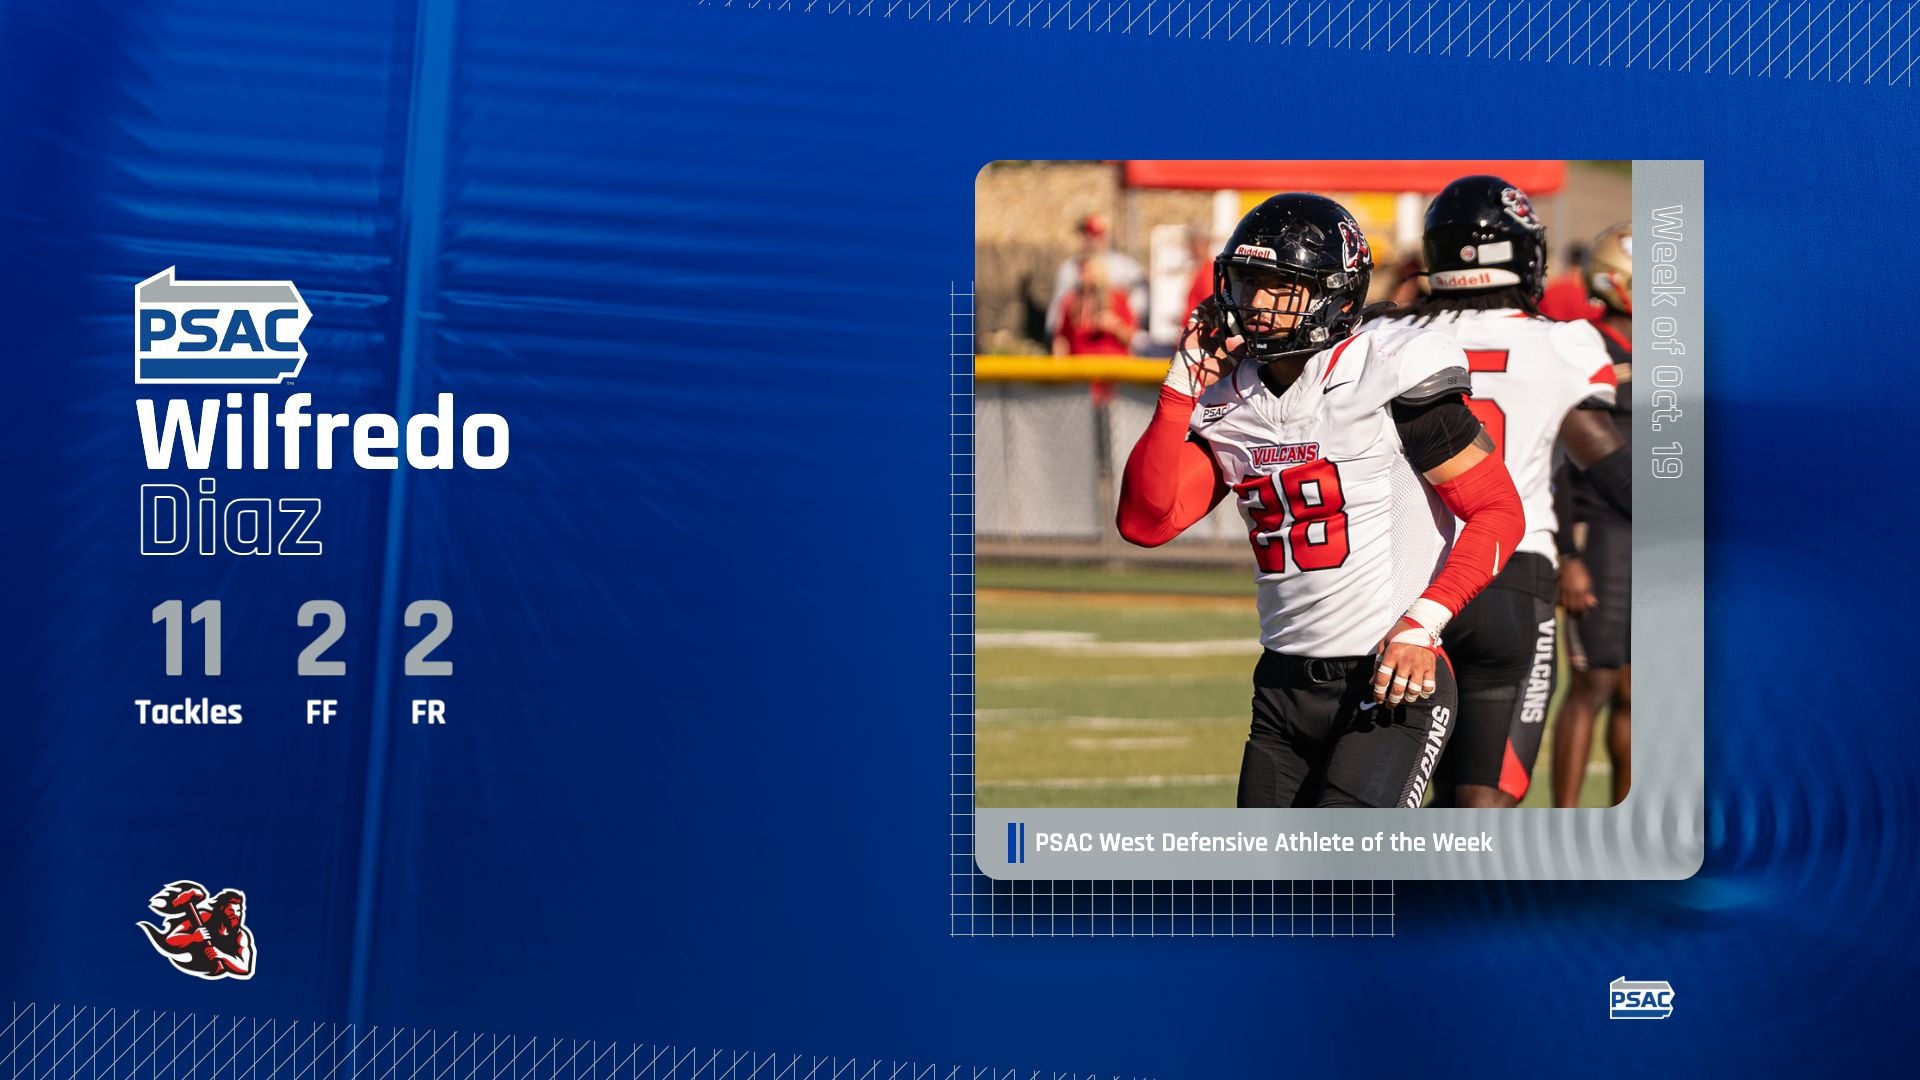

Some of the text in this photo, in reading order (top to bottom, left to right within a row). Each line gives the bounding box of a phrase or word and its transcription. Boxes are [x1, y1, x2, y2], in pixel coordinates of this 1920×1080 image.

[1238, 246, 1271, 259] Riddell
[1203, 406, 1228, 418] PSAC
[1251, 443, 1319, 468] VULCANS
[1233, 457, 1351, 574] 28
[1520, 617, 1556, 724] VULCANS
